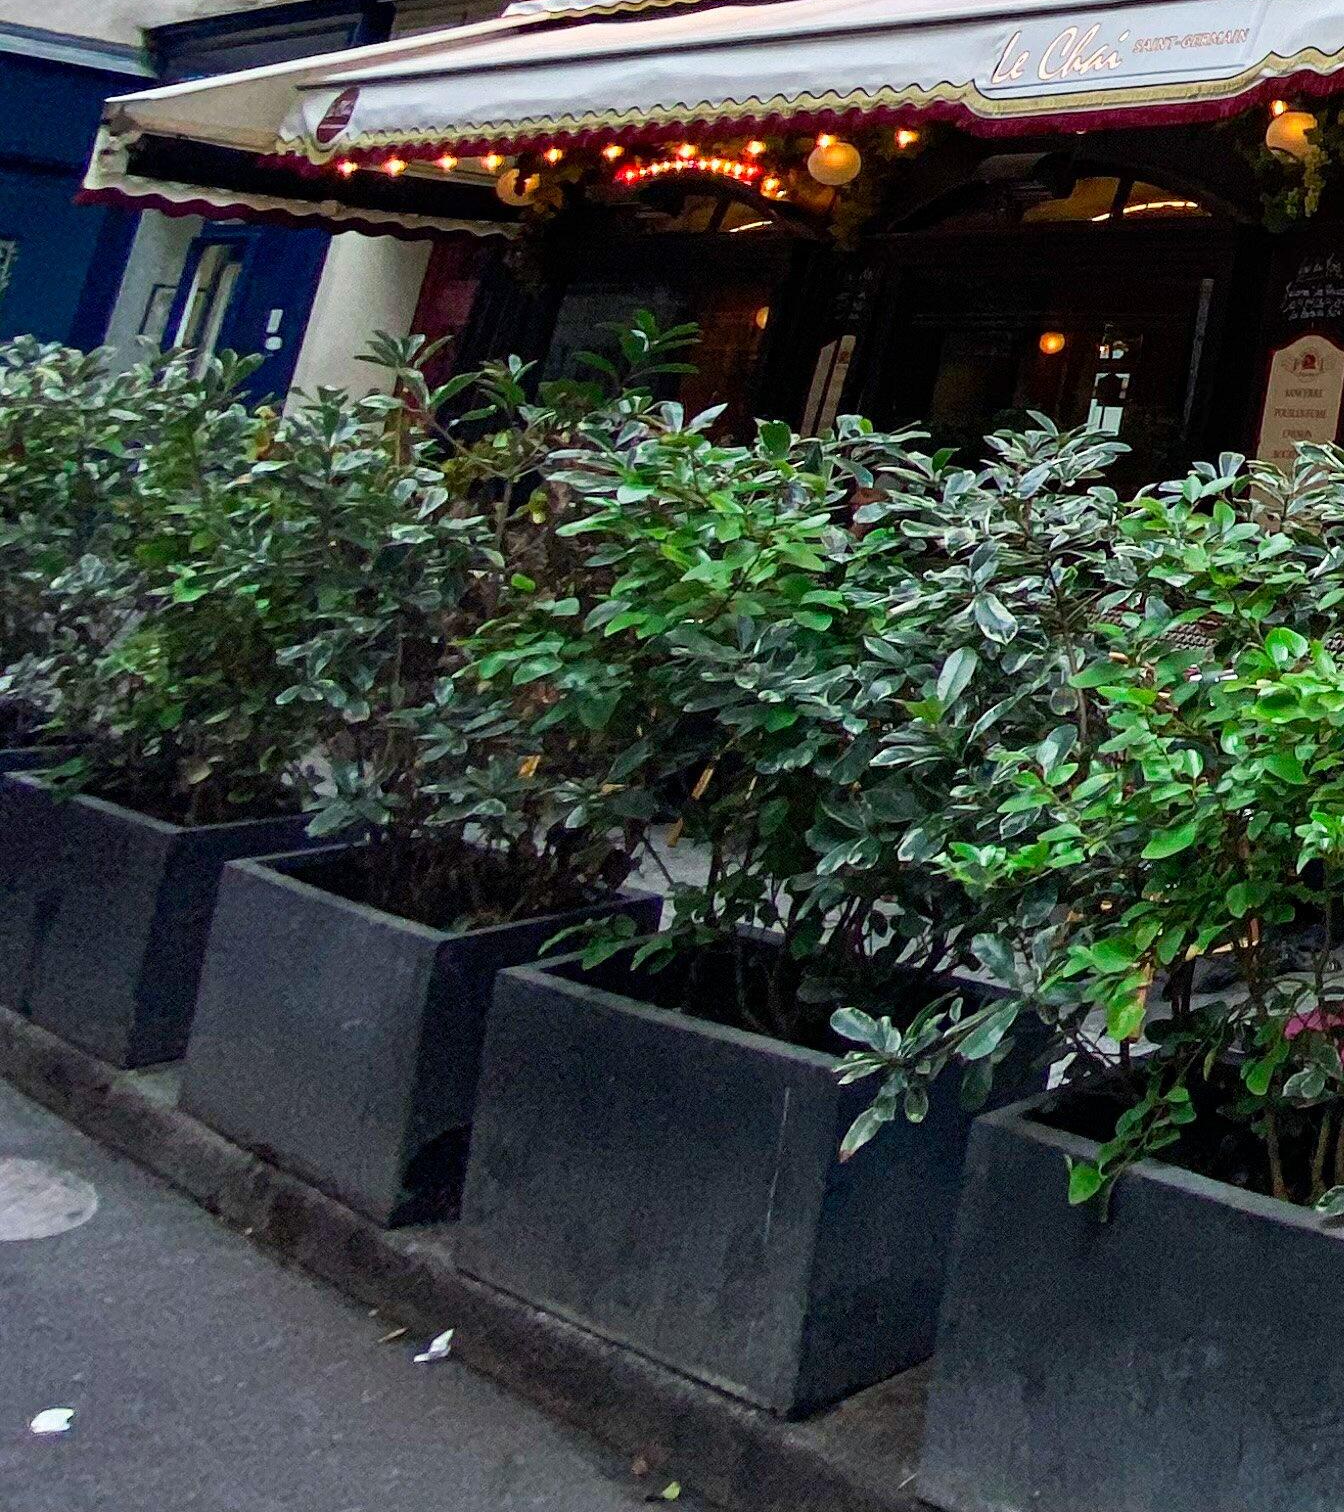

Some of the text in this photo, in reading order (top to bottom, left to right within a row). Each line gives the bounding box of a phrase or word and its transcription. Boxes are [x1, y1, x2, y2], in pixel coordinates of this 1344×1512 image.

[991, 23, 1251, 84] Le Chai SAINT-GERMAIN
